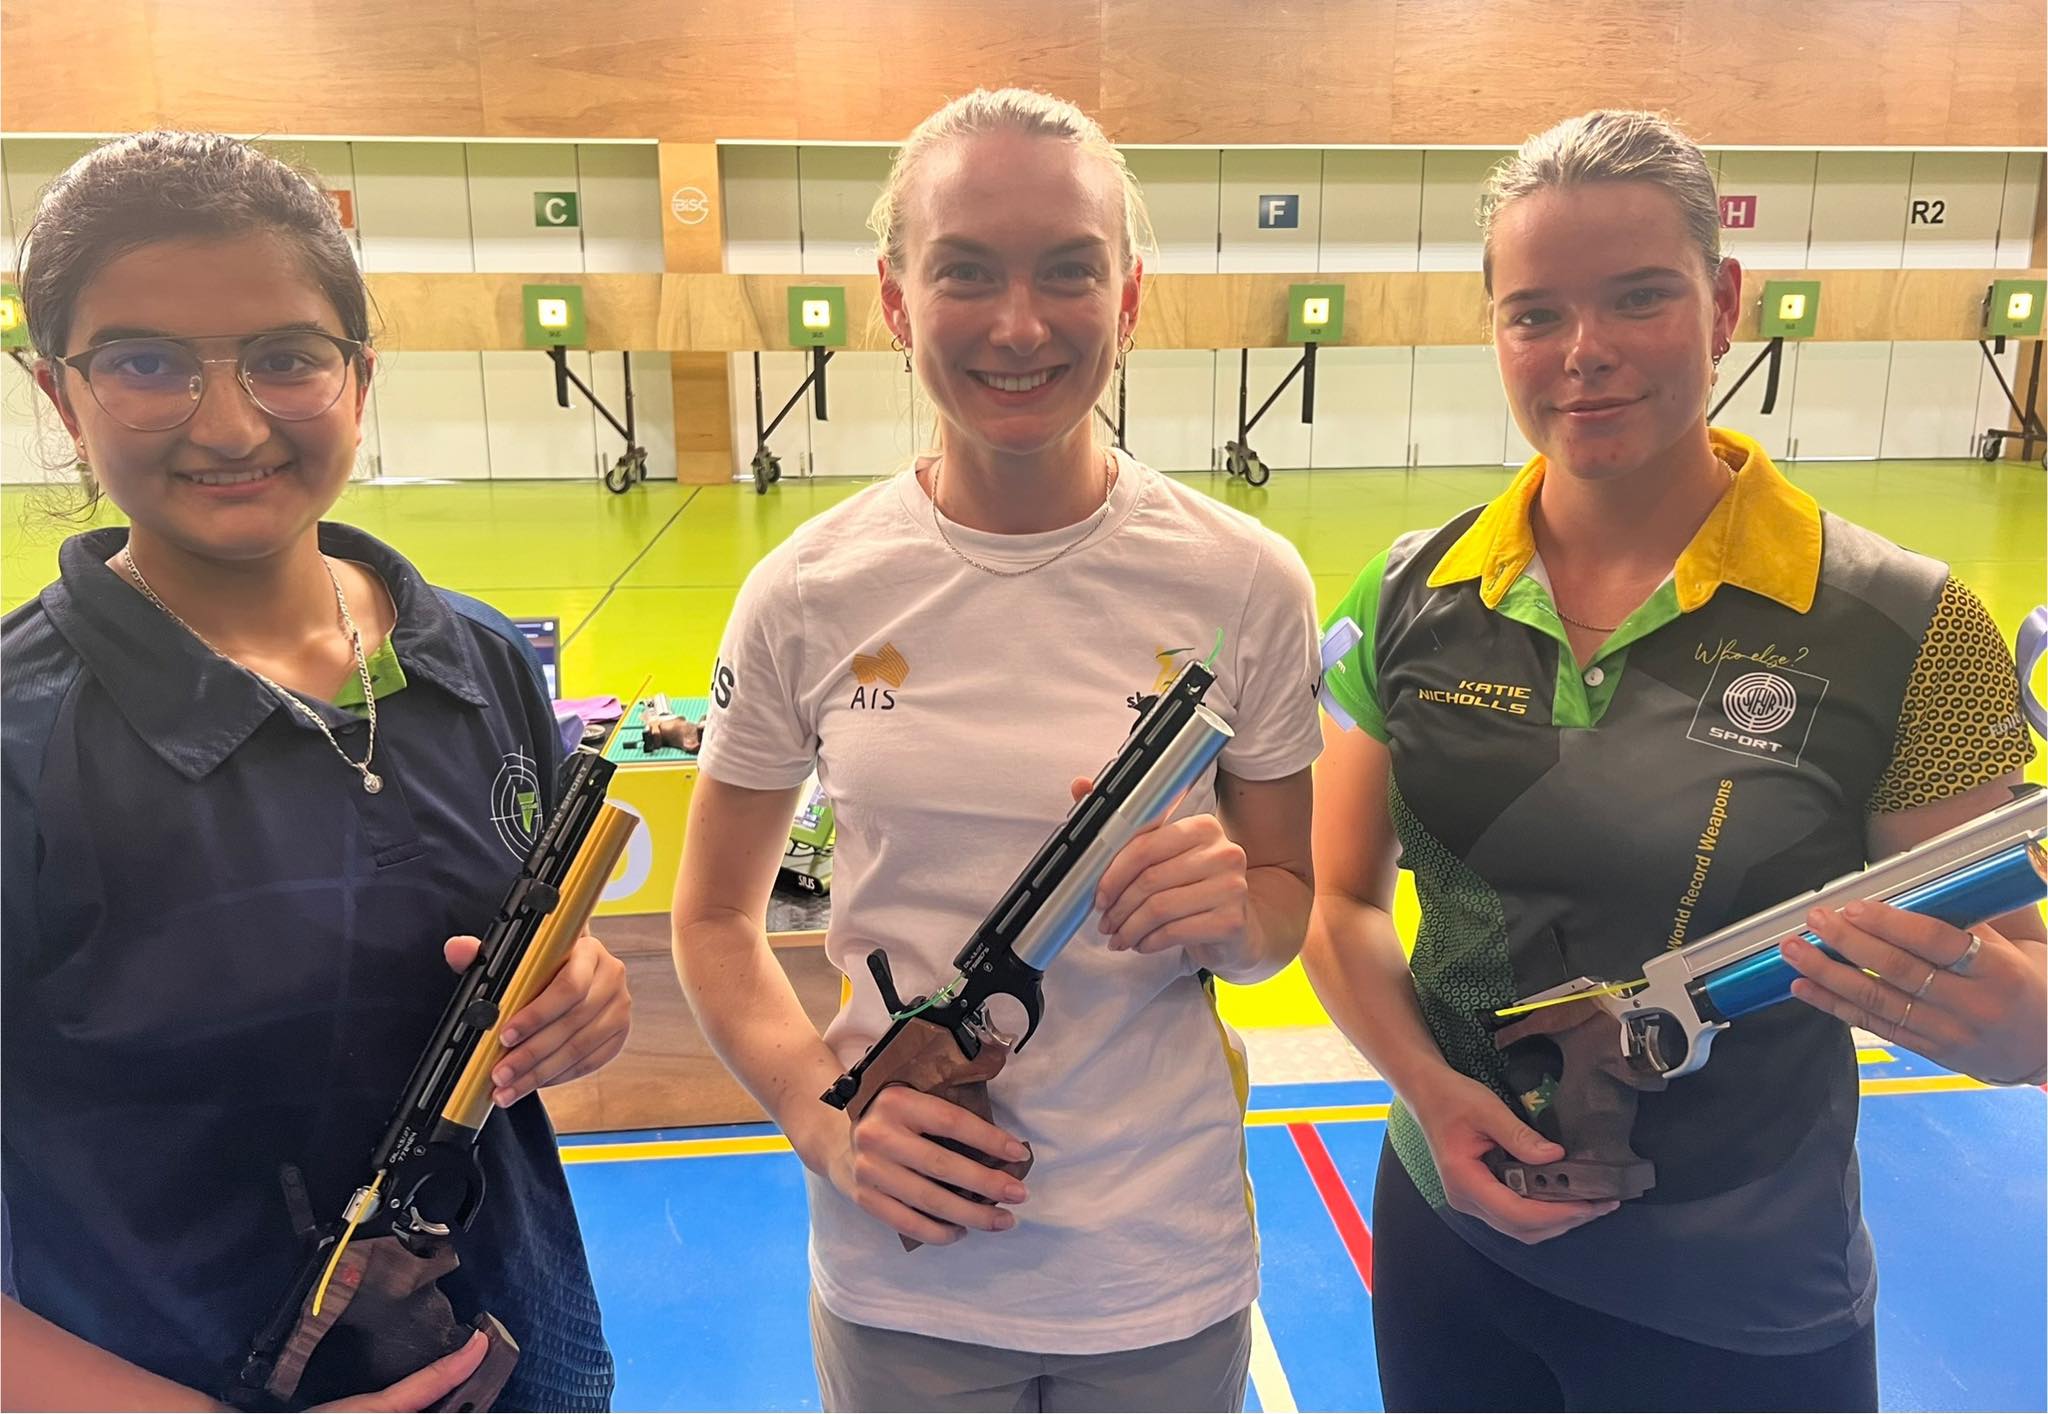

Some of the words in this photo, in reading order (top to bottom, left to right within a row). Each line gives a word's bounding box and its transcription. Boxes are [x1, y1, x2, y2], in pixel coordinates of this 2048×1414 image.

[545, 197, 568, 224] C
[1268, 200, 1286, 225] F
[1726, 201, 1746, 225] H
[1911, 200, 1945, 224] R2
[850, 685, 898, 710] AIS
[1419, 688, 1528, 715] NICHOLLS
[1458, 680, 1532, 699] KATIE
[1708, 726, 1783, 753] SPORT
[1666, 907, 1692, 951] World
[1680, 853, 1712, 907] Record
[1697, 778, 1734, 852] Weapons
[798, 875, 816, 890] SIUS
